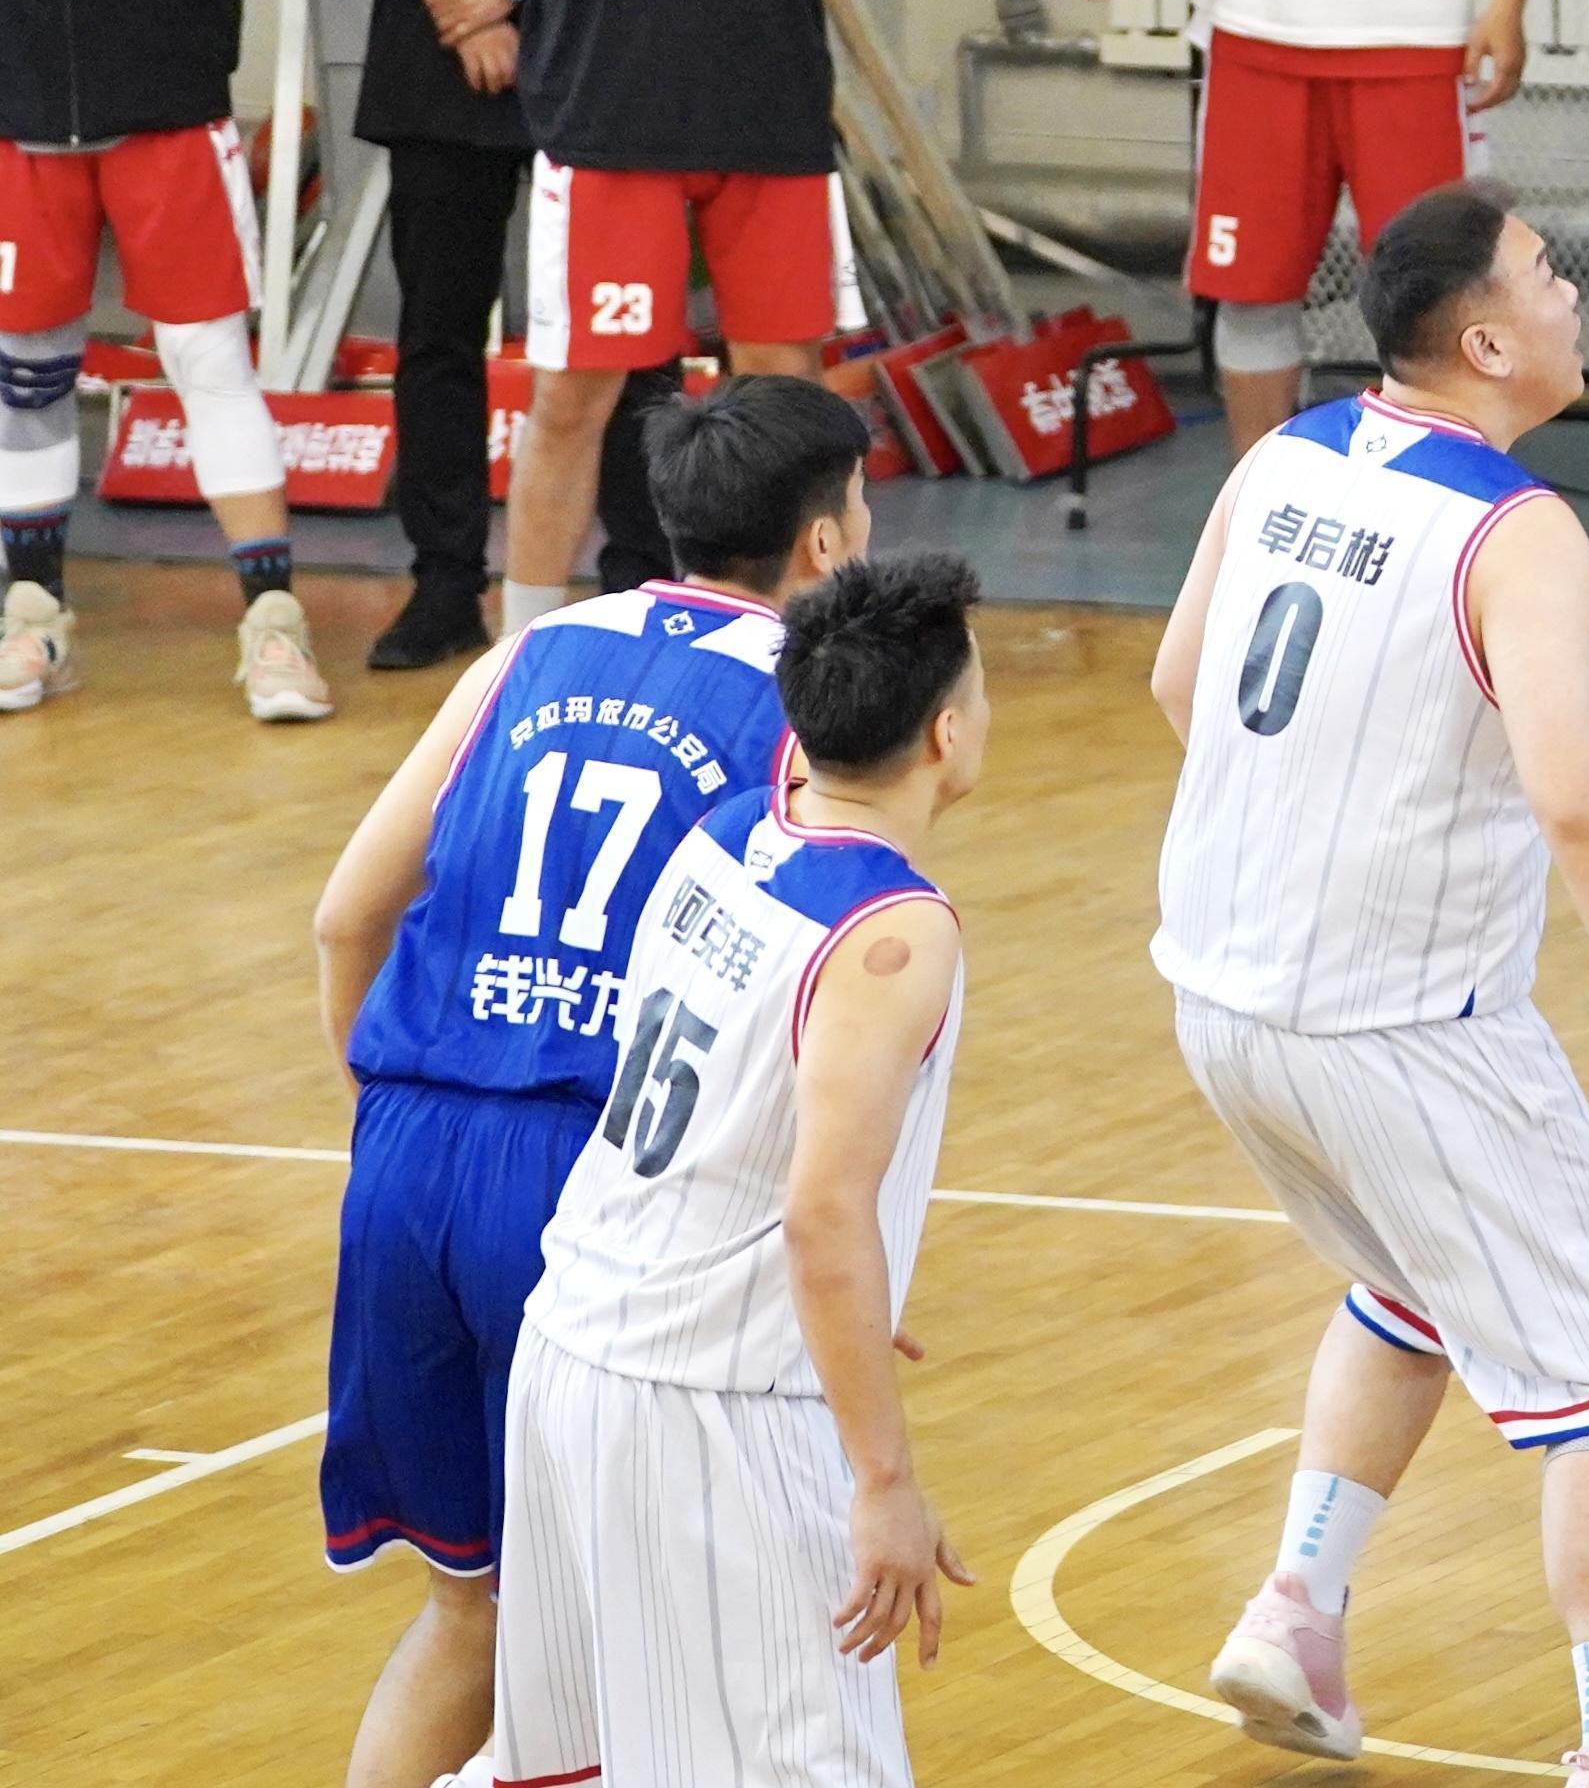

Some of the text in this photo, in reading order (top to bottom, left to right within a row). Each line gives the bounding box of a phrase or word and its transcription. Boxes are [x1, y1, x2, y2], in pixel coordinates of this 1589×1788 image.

[1206, 215, 1238, 266] 5
[590, 281, 653, 335] 23
[1258, 503, 1395, 586] 卓启彬
[1238, 581, 1324, 736] 0
[510, 696, 727, 795] 克拉玛依市公安局
[498, 750, 663, 952] 17
[602, 987, 719, 1179] 15
